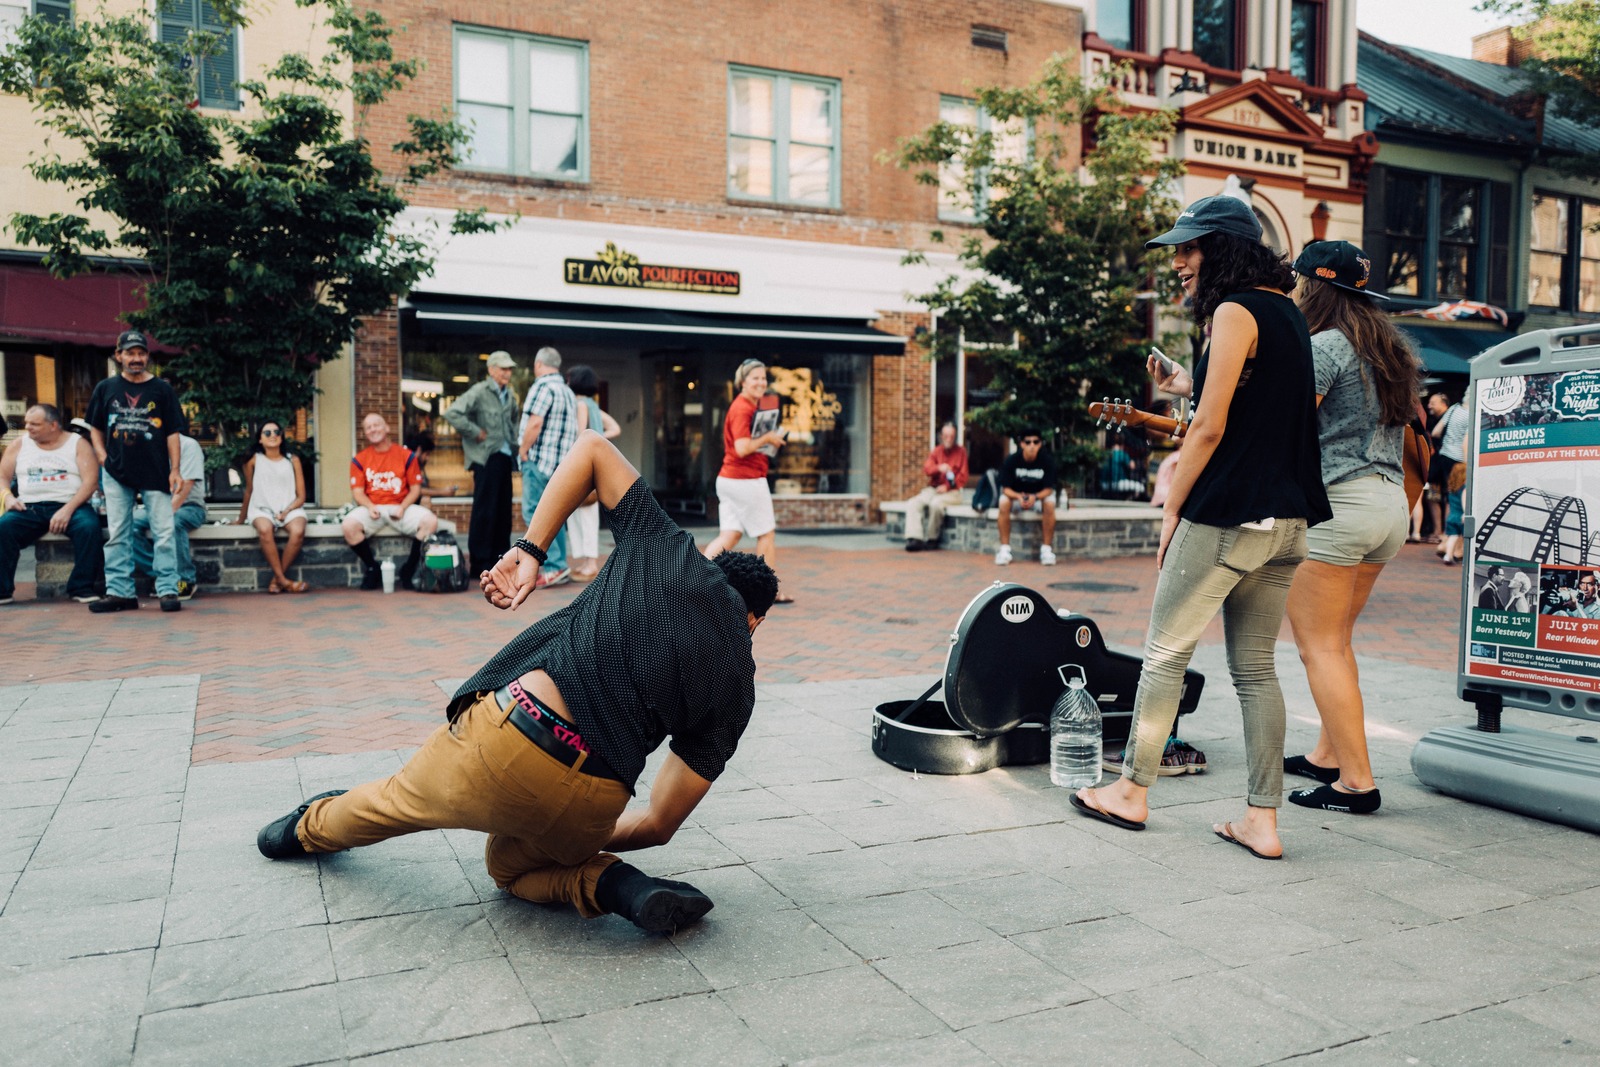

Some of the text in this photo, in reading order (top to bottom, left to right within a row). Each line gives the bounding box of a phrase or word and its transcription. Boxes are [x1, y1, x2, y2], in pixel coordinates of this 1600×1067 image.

[1194, 139, 1297, 168] UNION BANK
[567, 261, 641, 287] FLAVOR
[642, 266, 739, 286] POURFECTION
[1481, 386, 1514, 400] Town
[1565, 385, 1600, 395] MOVIE
[1562, 394, 1598, 413] Night
[1488, 428, 1545, 442] SATURDAYS
[1487, 440, 1519, 449] BEGINNING
[1508, 448, 1600, 461] LOCATED AT THE TAYL
[1480, 613, 1530, 626] JUNE 11TH
[1549, 620, 1598, 632] JULY 9TH
[1476, 625, 1531, 639] Born Yesterday
[1546, 633, 1599, 645] Rear Window
[1502, 651, 1524, 659] HOSTED
[1556, 657, 1584, 667] LANTERN
[1512, 657, 1530, 665] location
[1501, 669, 1591, 687] OldTownWinchesterVA.com
